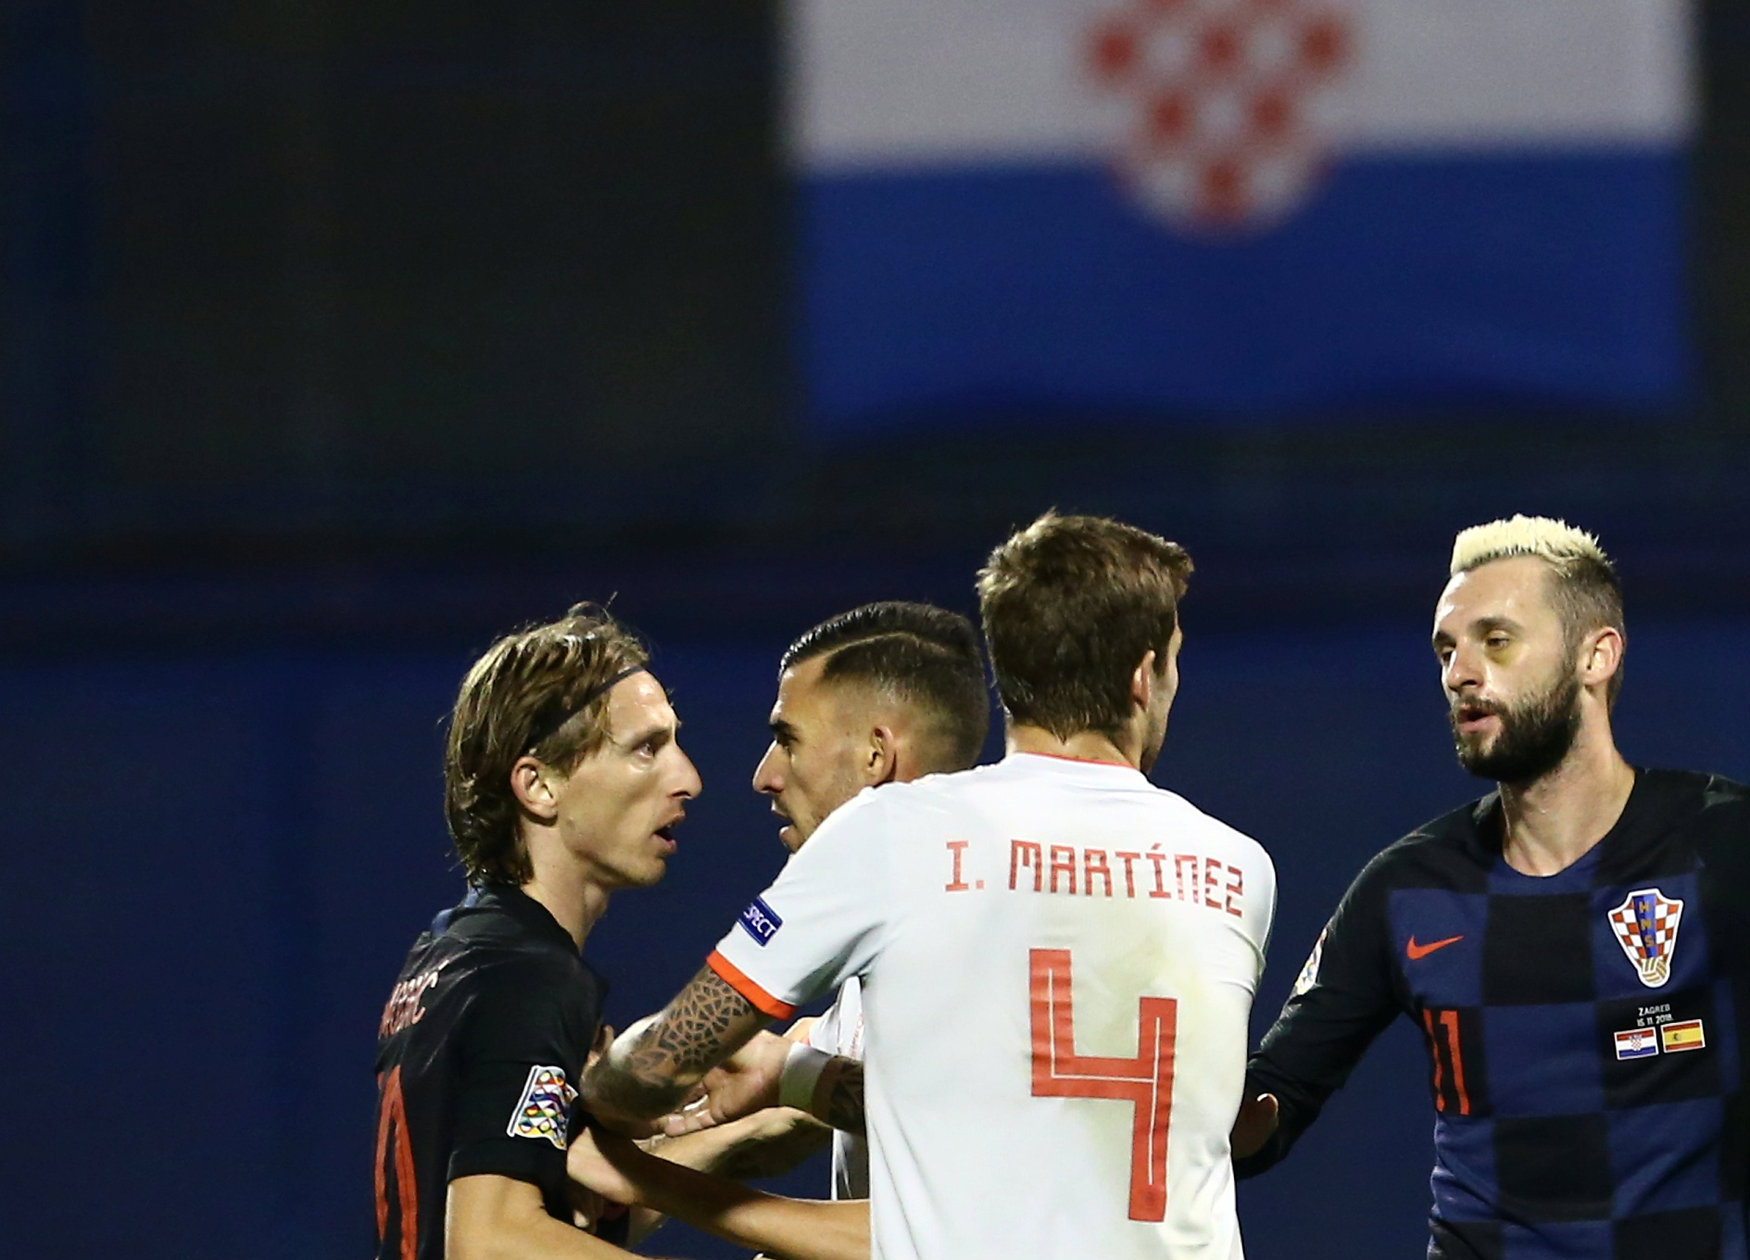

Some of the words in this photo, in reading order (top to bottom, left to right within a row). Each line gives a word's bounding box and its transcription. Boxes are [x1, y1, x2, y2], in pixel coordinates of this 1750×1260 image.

[945, 841, 984, 892] I.
[1008, 840, 1243, 918] MARTÍNEZ
[743, 904, 777, 937] SPECT
[1638, 1003, 1670, 1016] ZAGREB
[1029, 948, 1178, 1223] 4
[1423, 1009, 1470, 1115] 11
